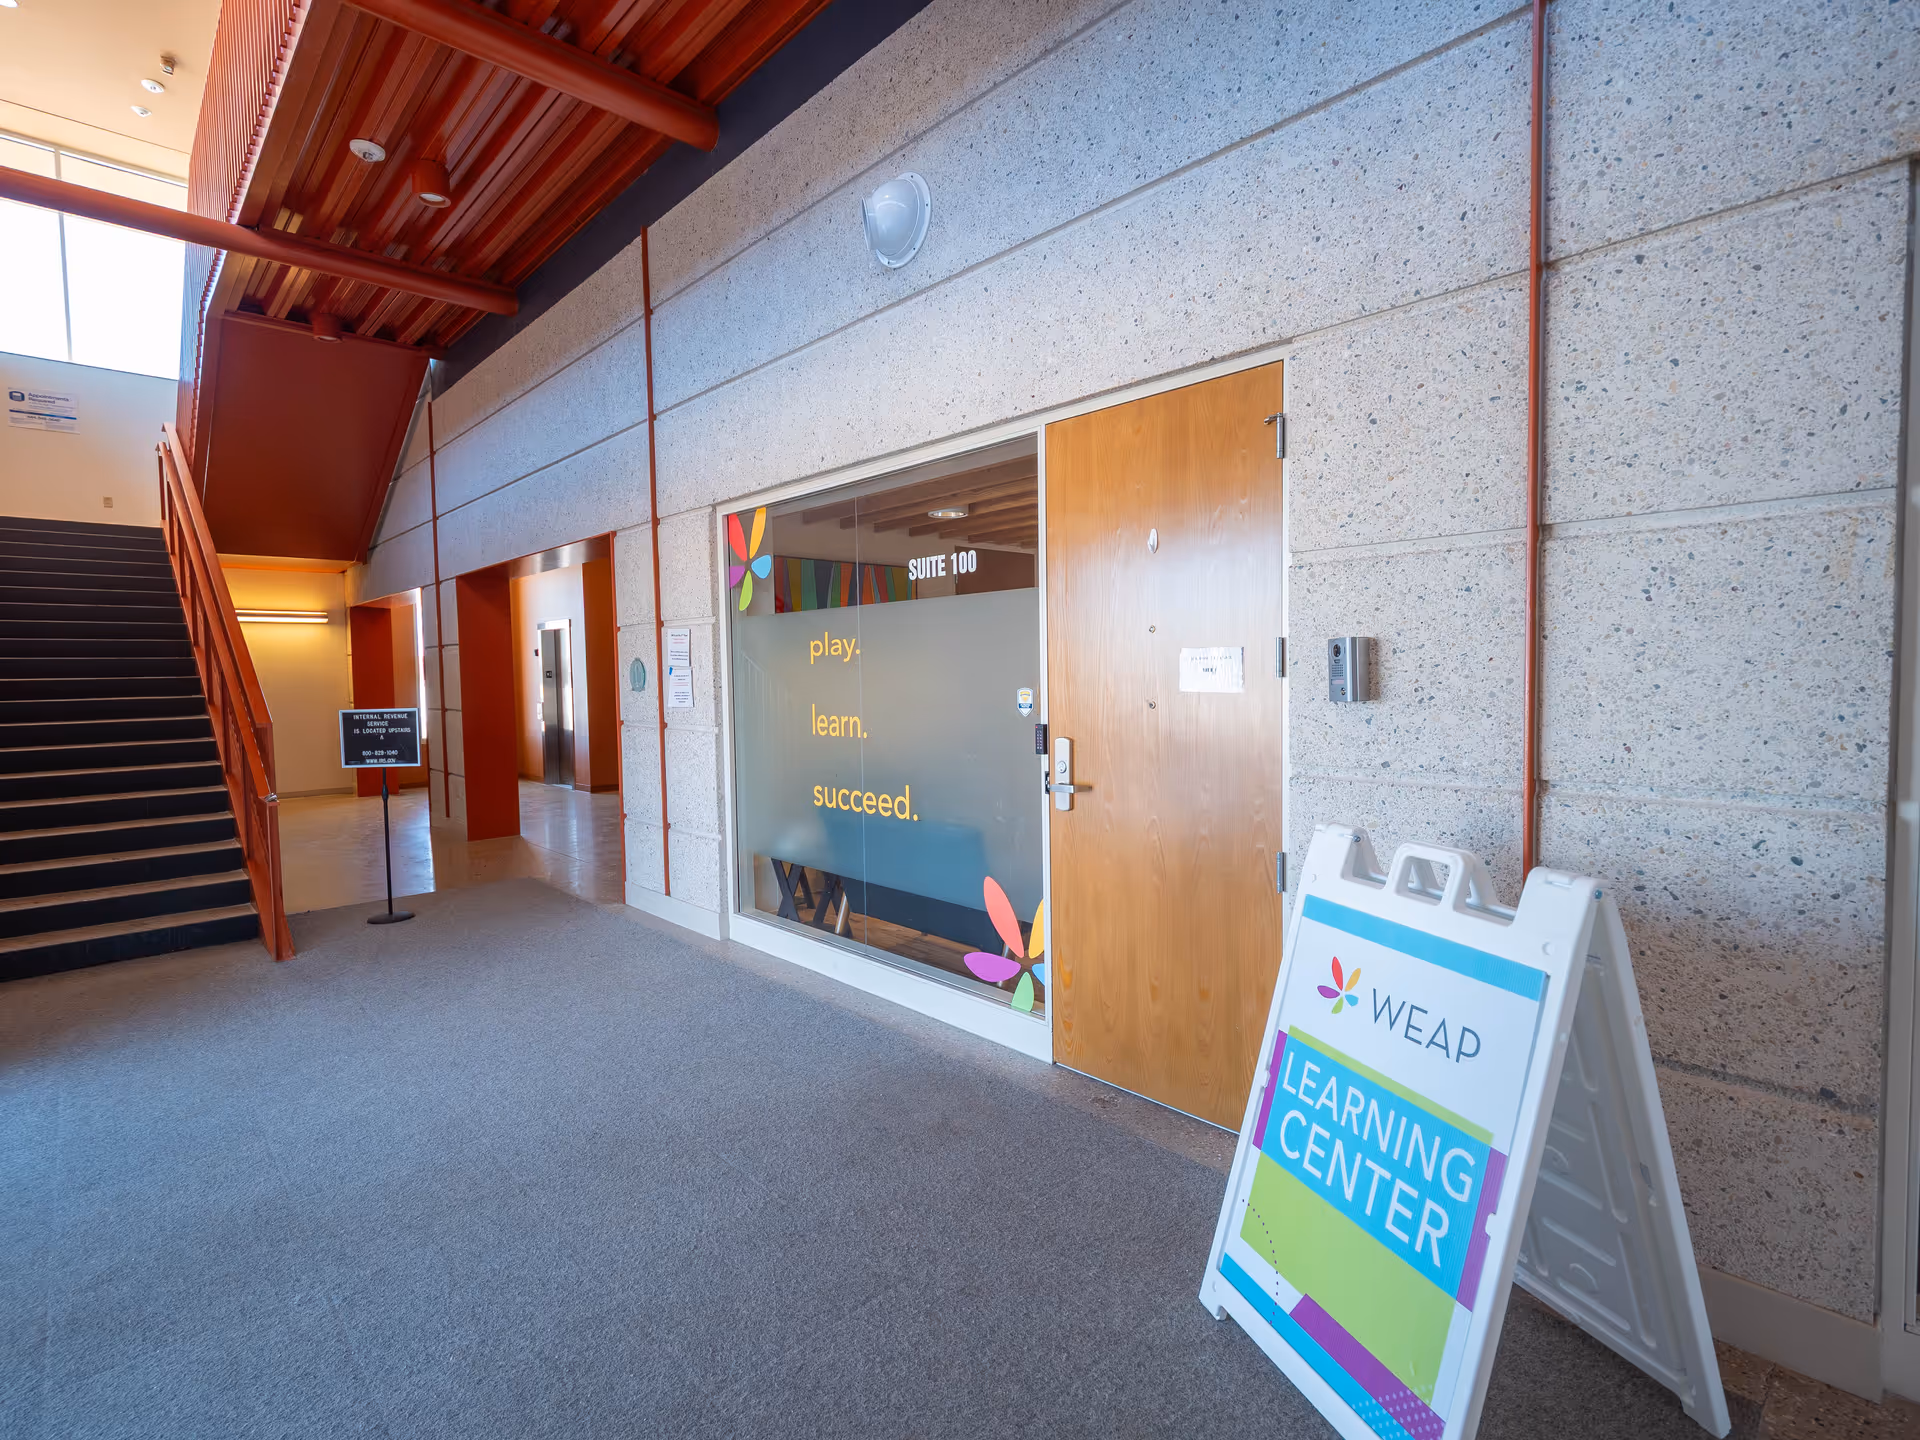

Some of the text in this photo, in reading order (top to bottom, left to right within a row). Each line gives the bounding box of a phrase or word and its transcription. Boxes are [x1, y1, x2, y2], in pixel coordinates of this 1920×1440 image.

[908, 549, 977, 581] SUITE 100
[809, 631, 861, 665] play.
[811, 703, 868, 739] learn.
[813, 784, 919, 822] succeed.
[1372, 987, 1482, 1064] WEAP
[1281, 1050, 1476, 1204] LEARNING
[1279, 1109, 1449, 1269] CENTER
